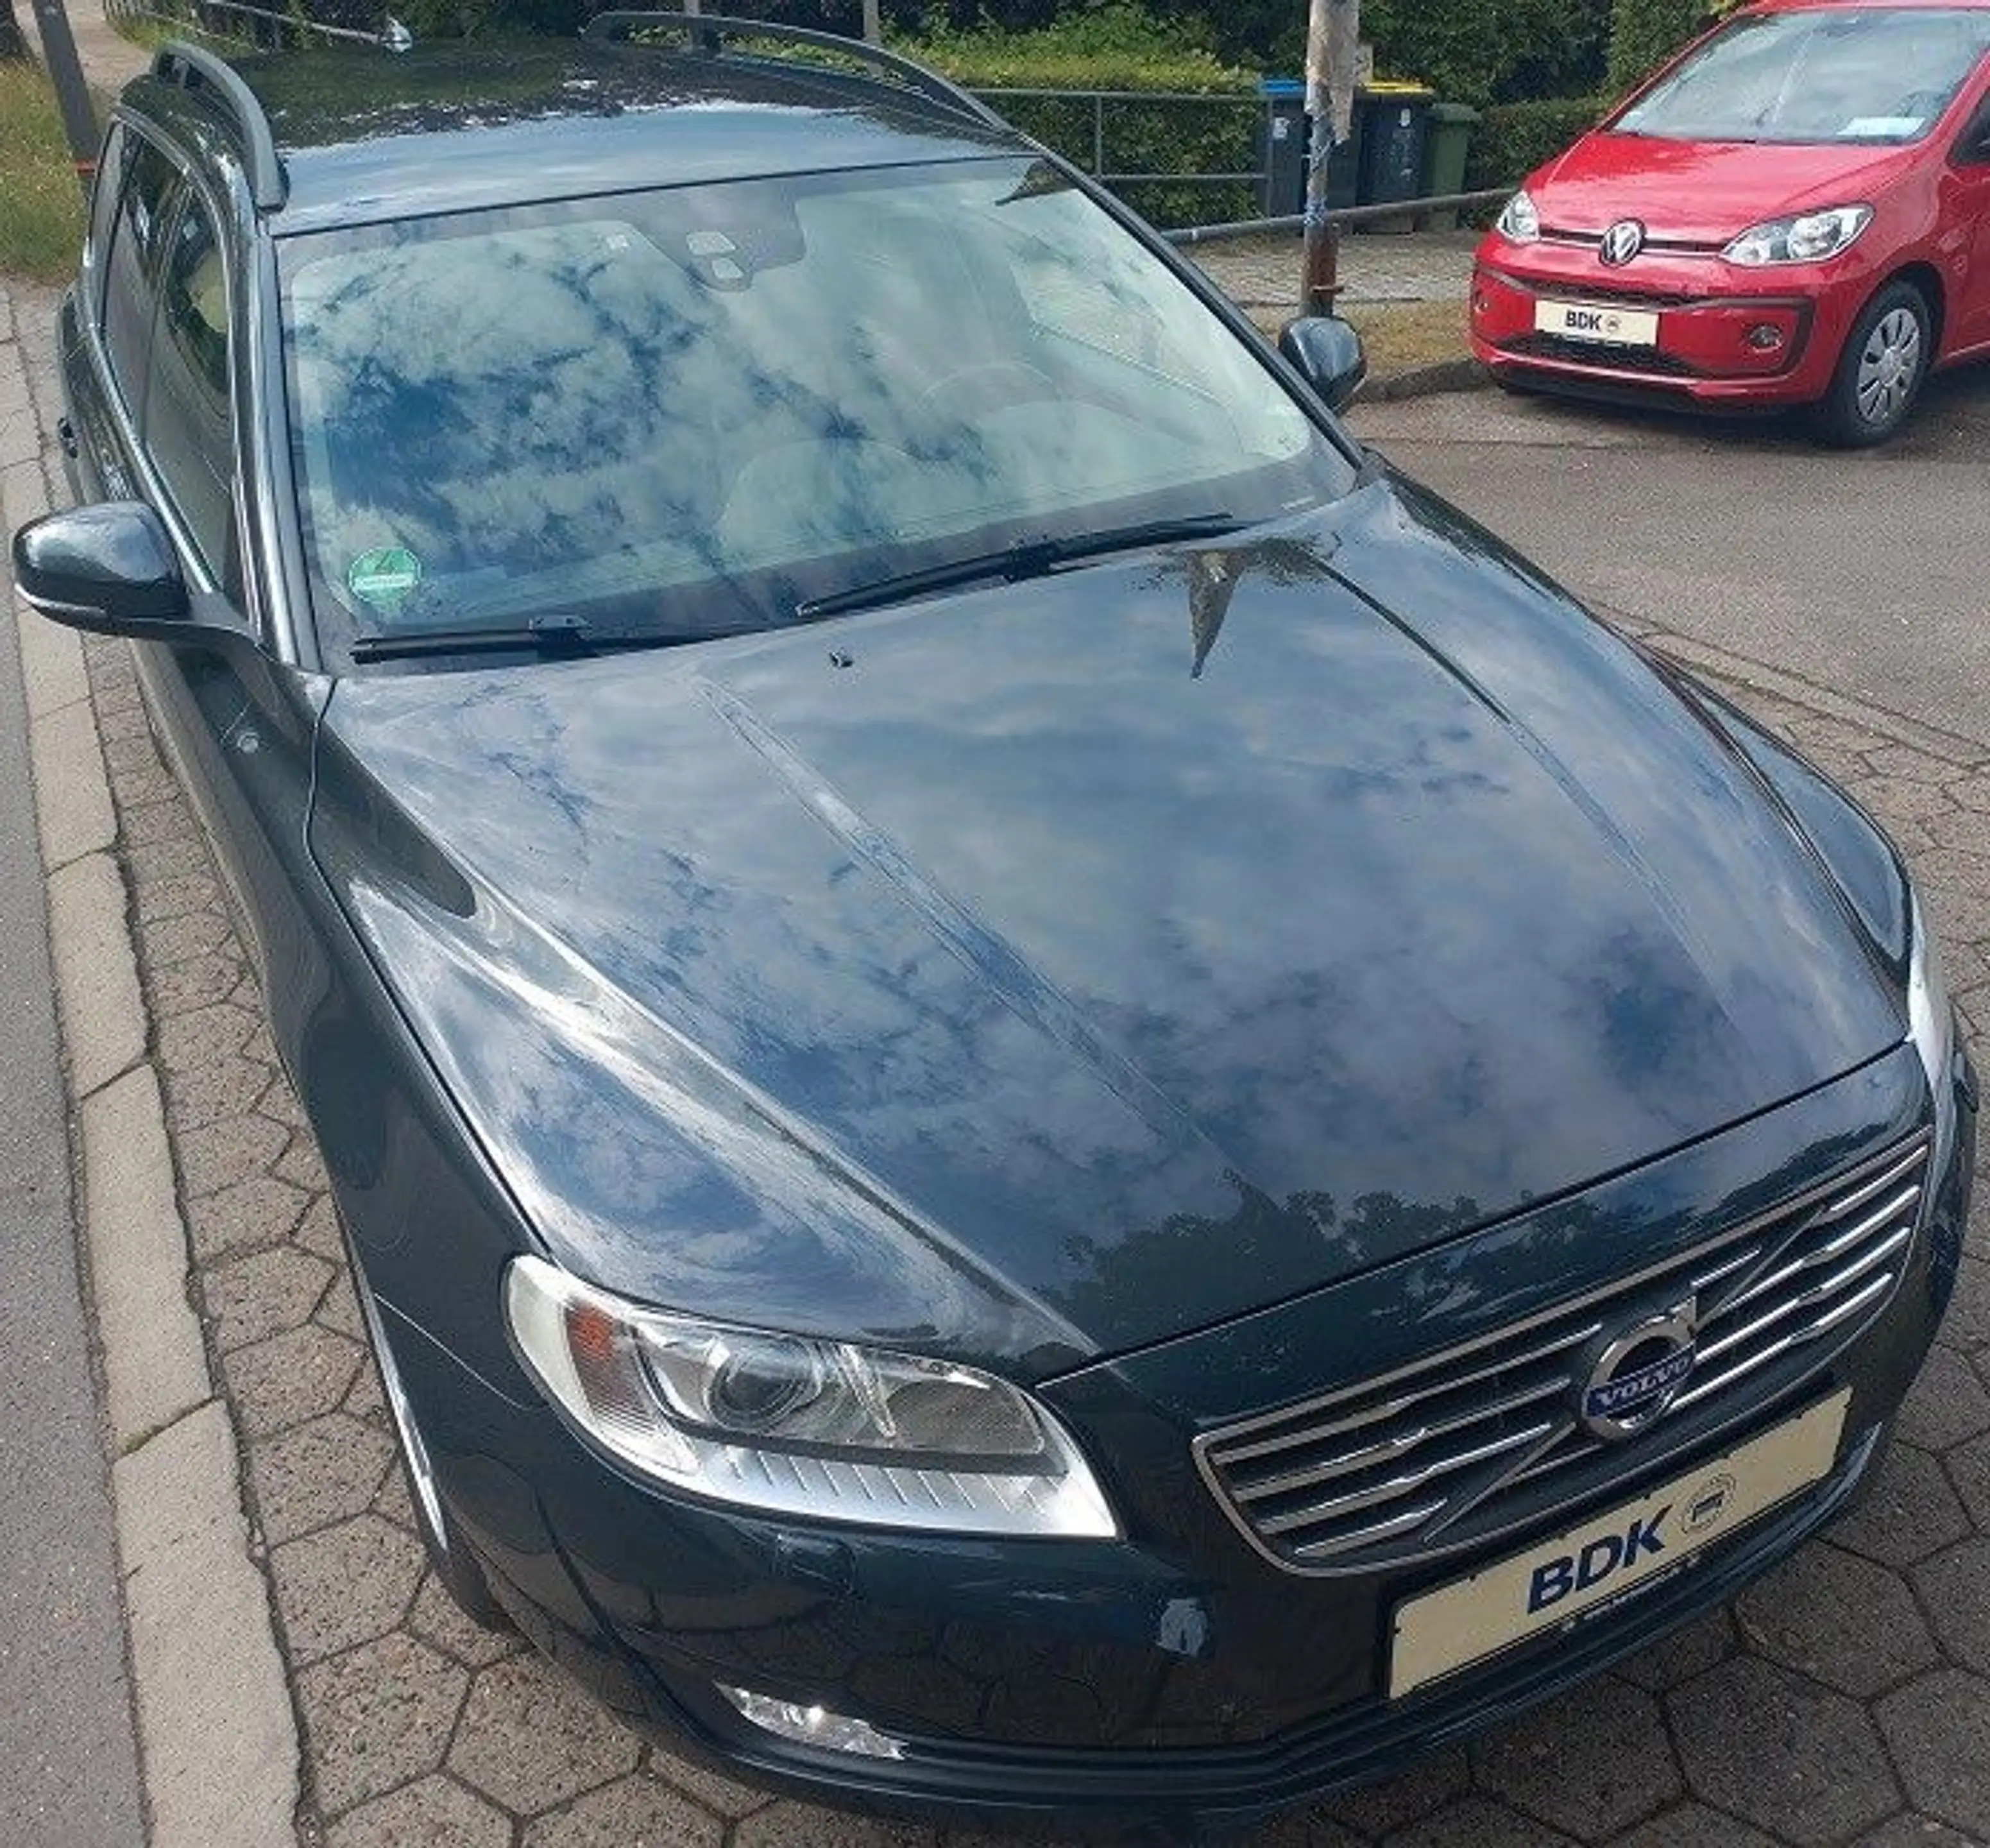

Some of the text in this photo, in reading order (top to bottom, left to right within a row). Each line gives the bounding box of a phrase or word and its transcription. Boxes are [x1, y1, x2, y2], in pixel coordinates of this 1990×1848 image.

[1565, 309, 1603, 331] BDK
[1595, 1355, 1690, 1406] VOLVO
[1527, 1503, 1673, 1614] BDK
